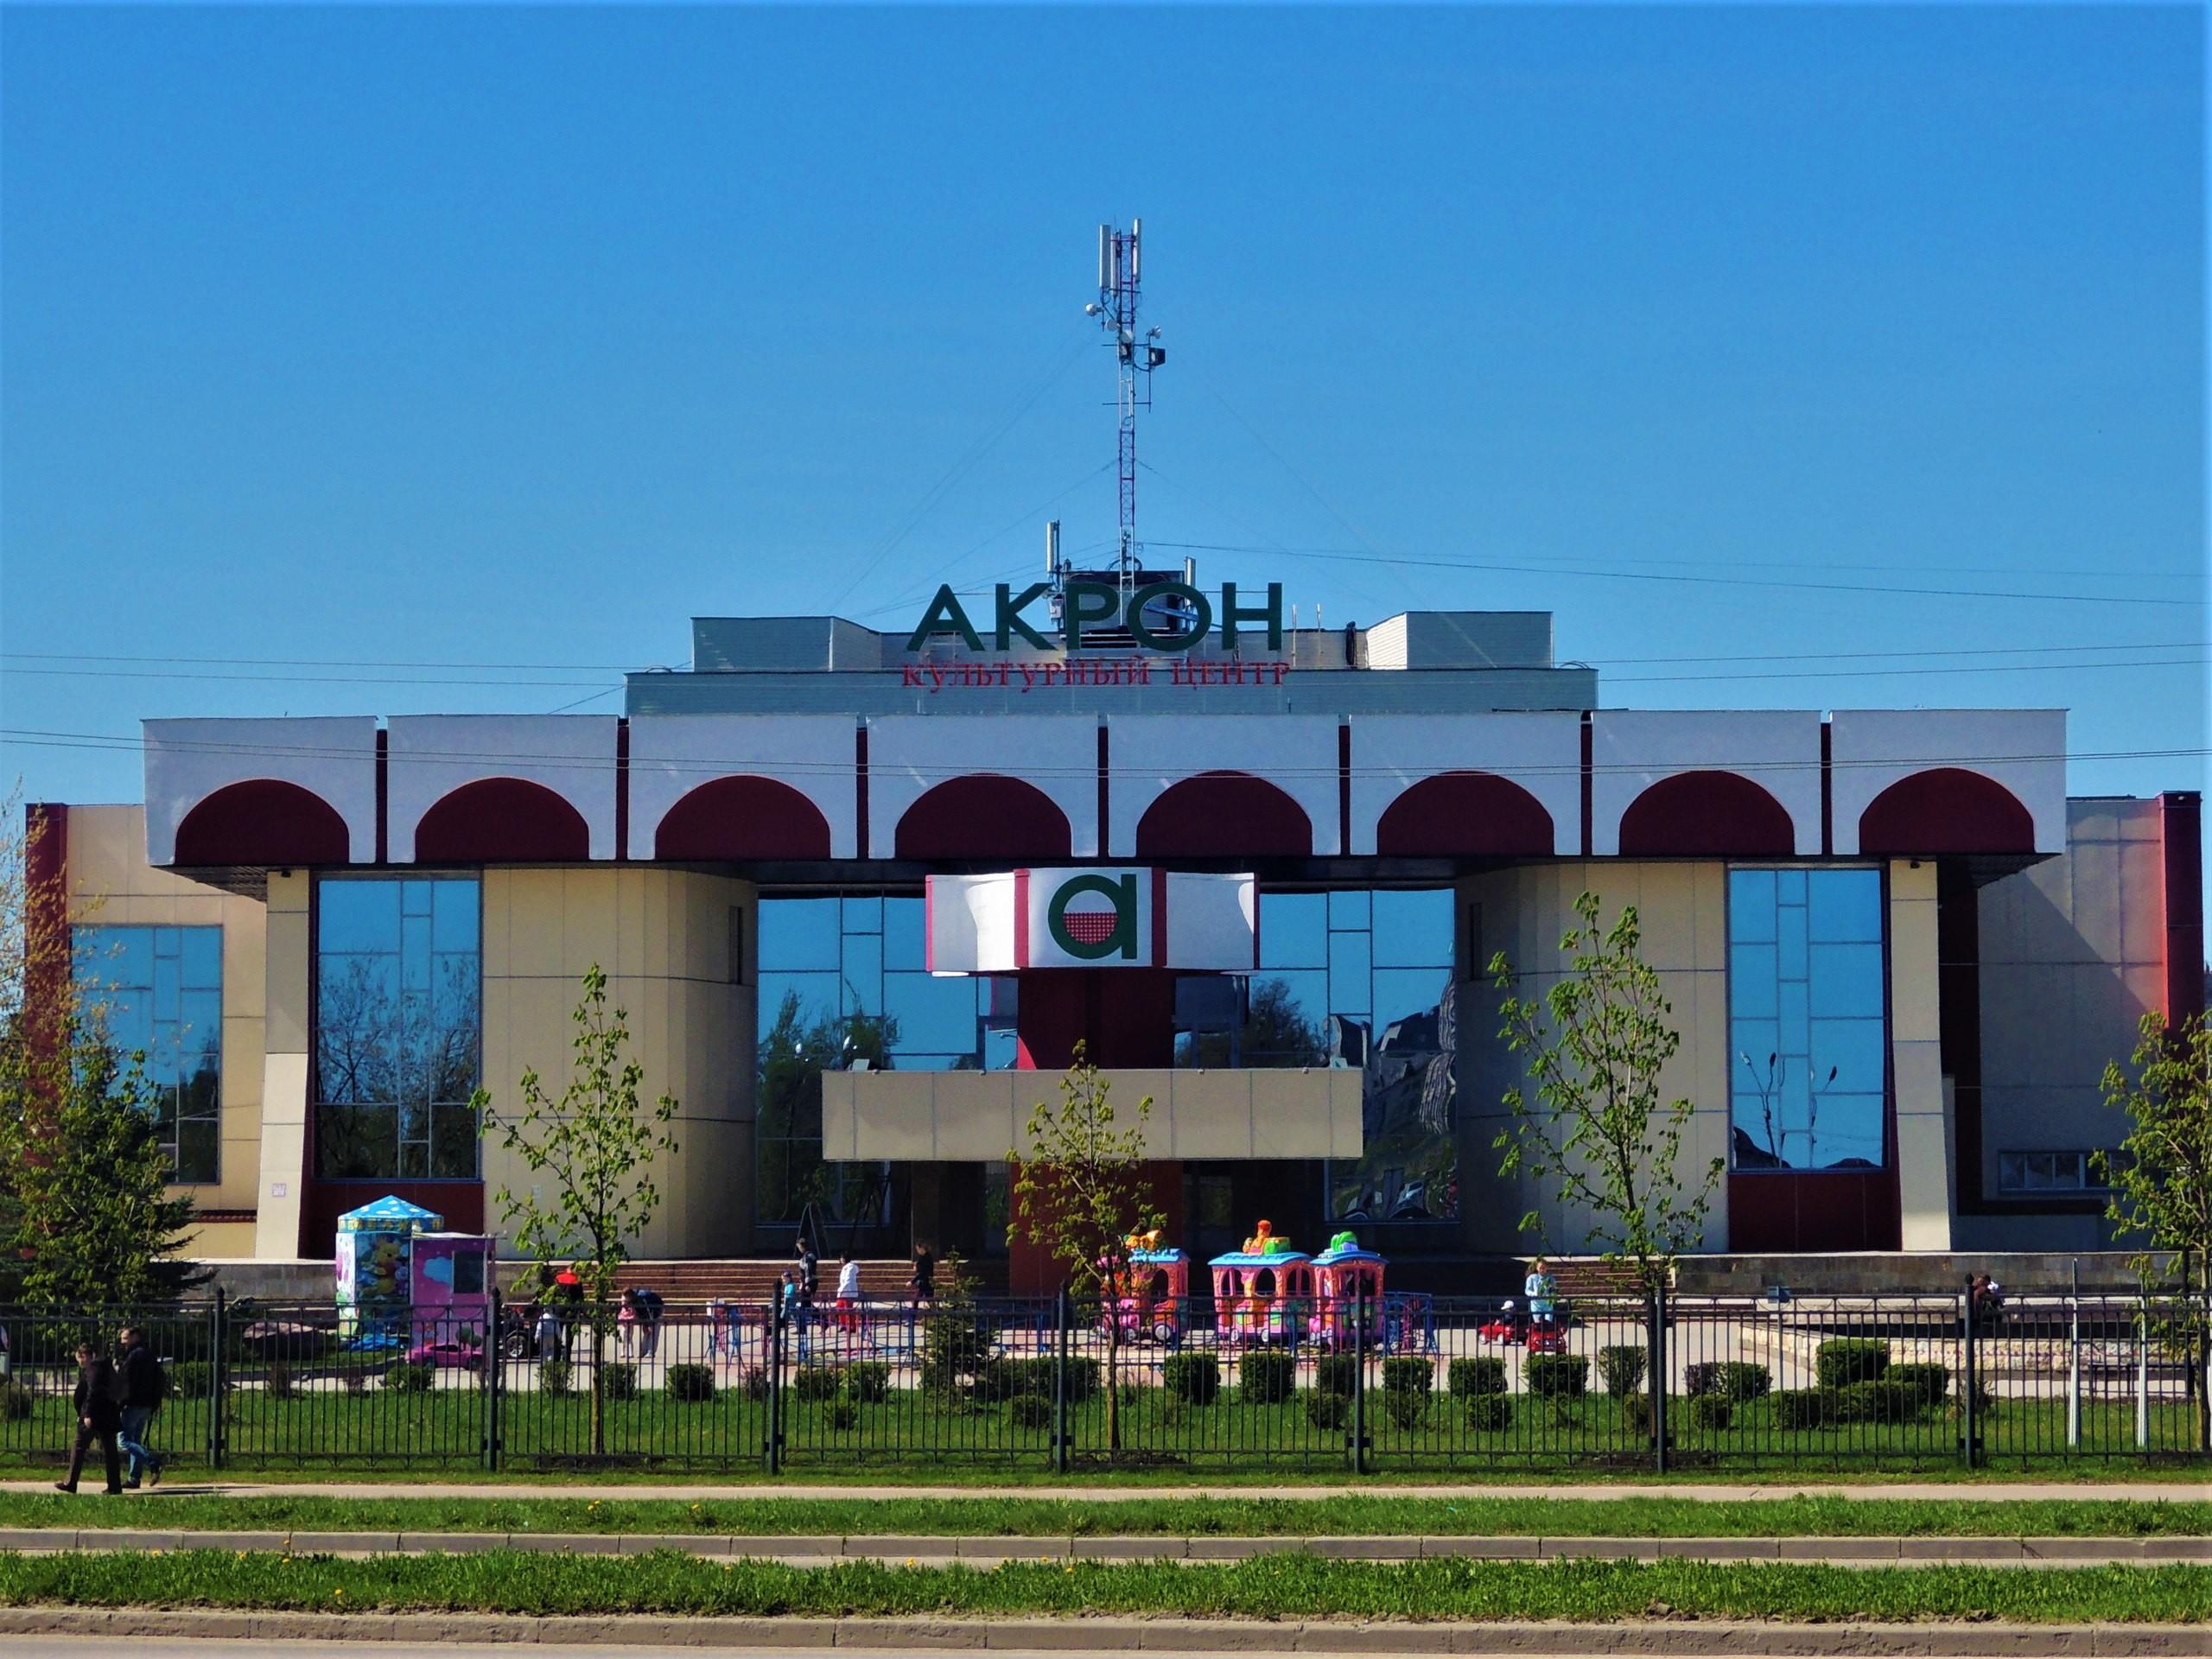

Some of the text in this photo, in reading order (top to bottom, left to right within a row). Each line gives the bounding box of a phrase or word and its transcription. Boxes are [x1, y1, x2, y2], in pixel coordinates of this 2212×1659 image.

[906, 582, 1282, 652] АКРОН
[902, 655, 1291, 693] КУЛЬТУРНЫЙ ЦЕНТР
